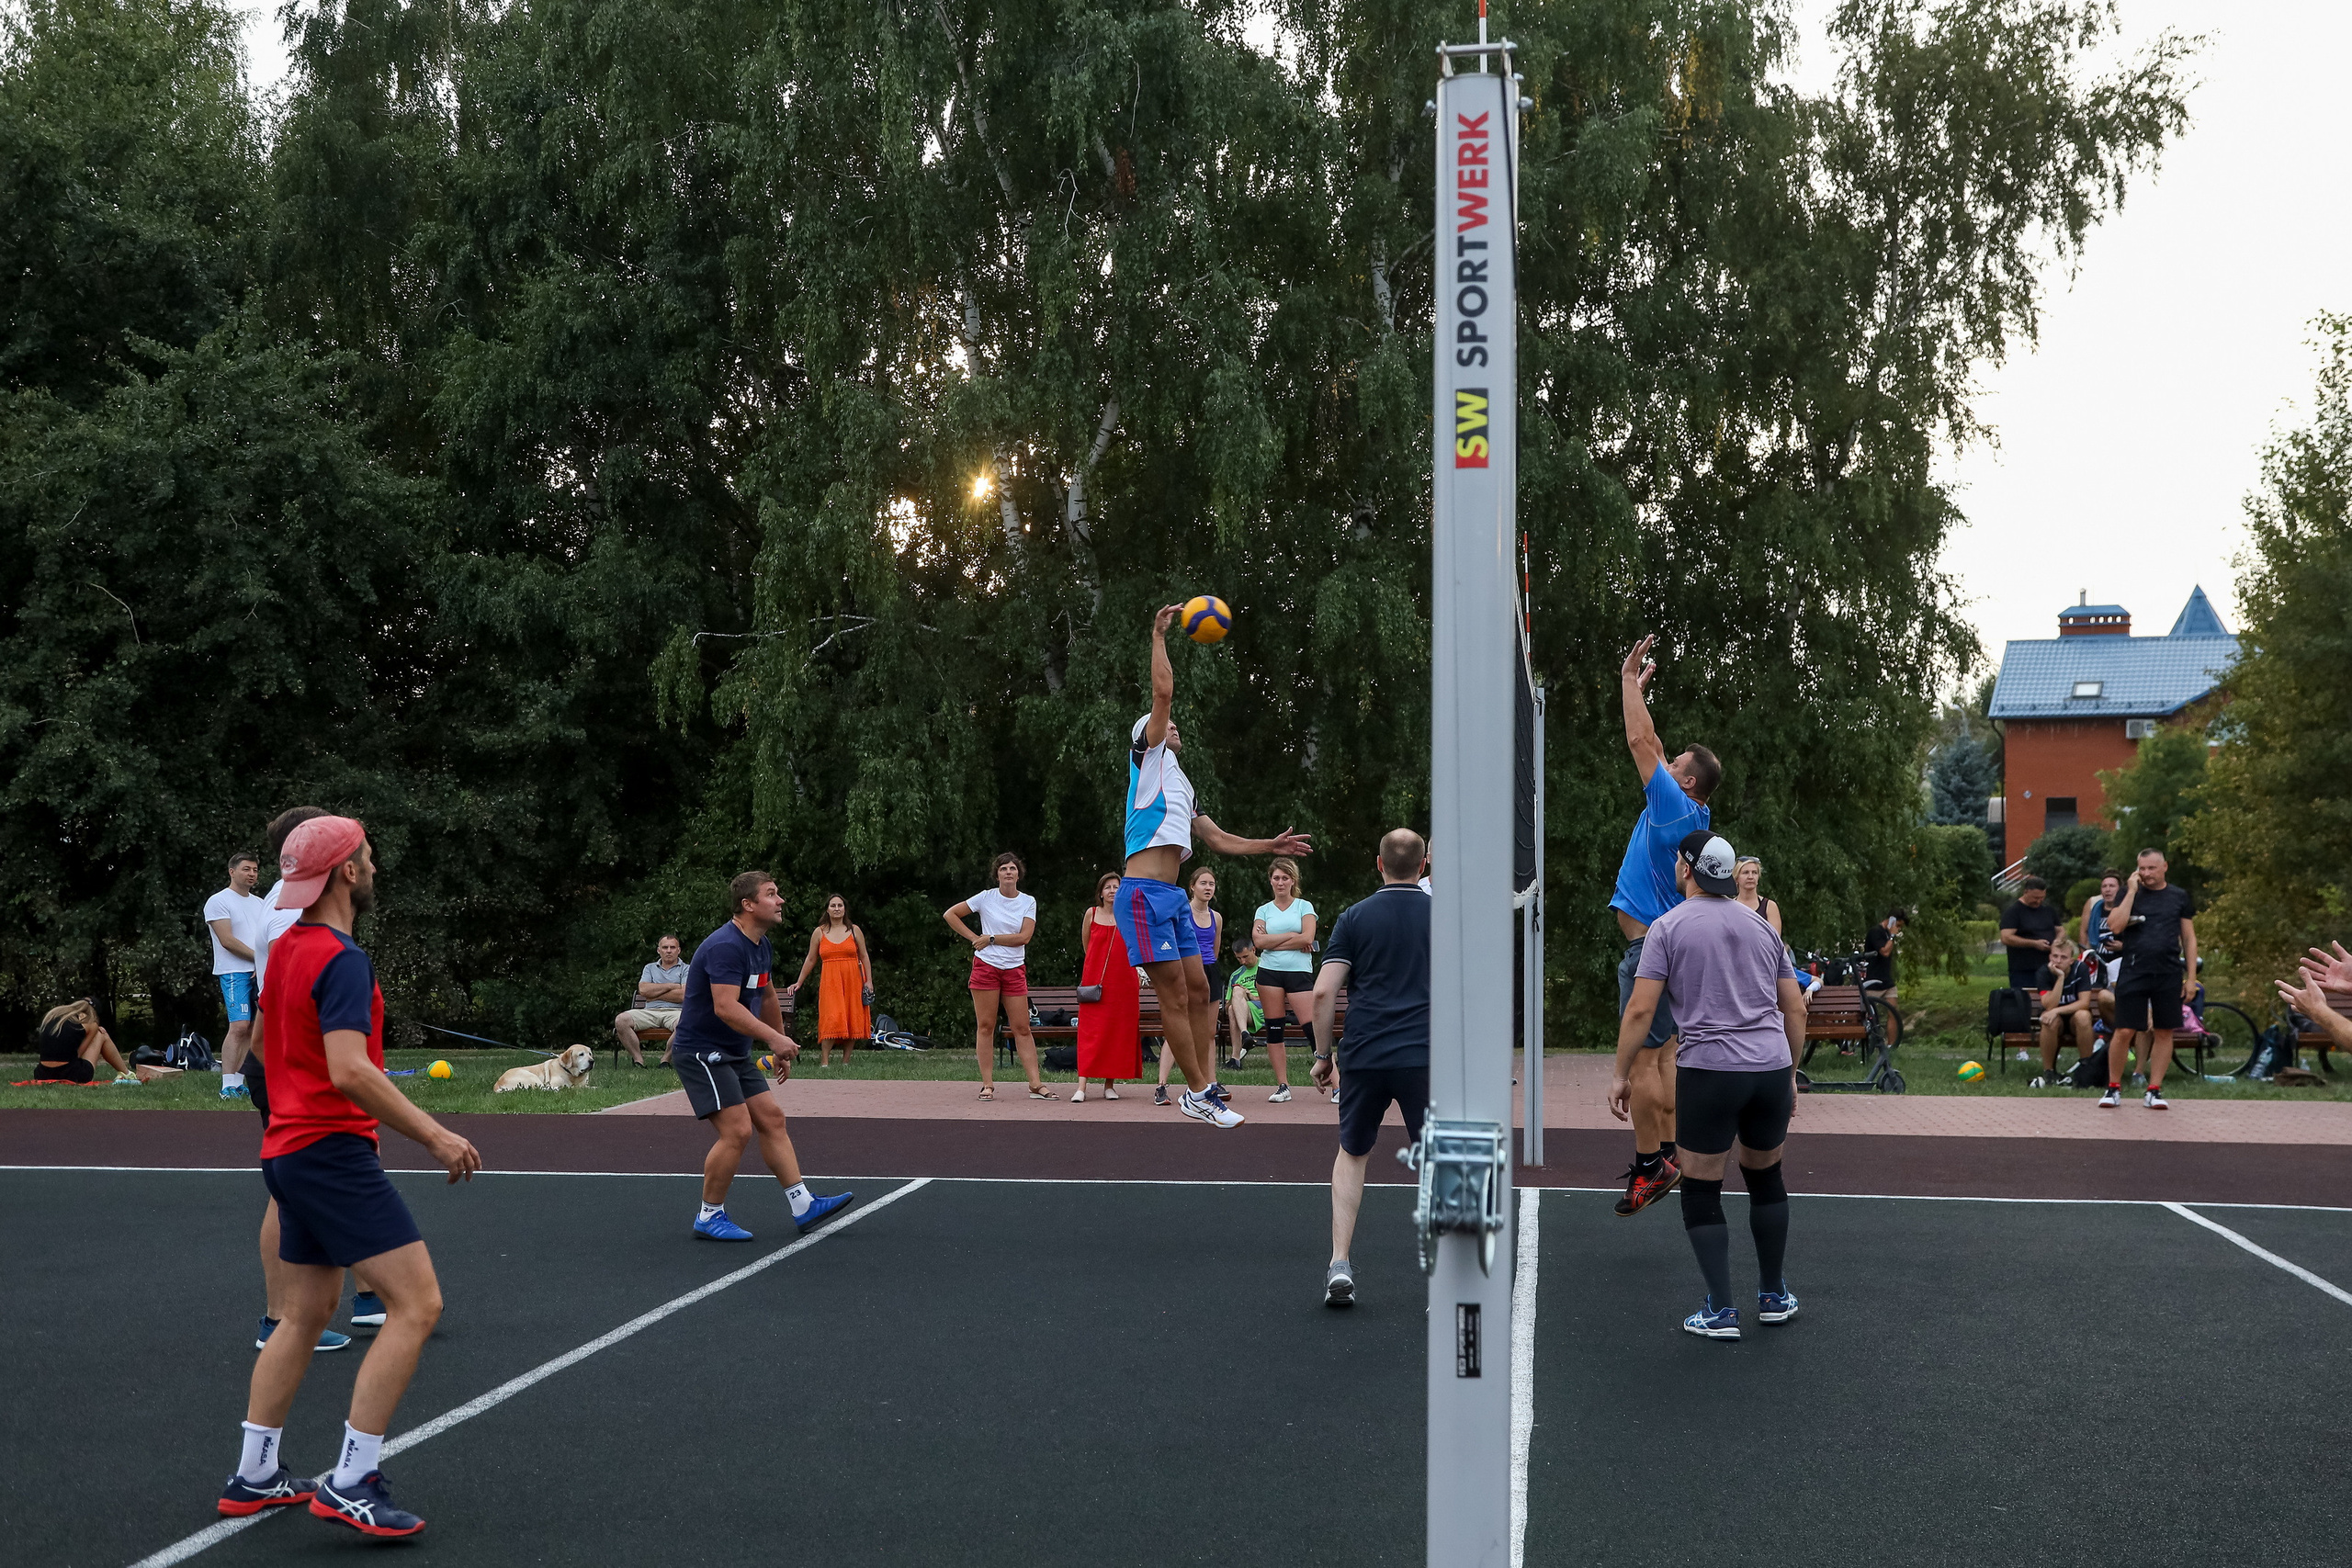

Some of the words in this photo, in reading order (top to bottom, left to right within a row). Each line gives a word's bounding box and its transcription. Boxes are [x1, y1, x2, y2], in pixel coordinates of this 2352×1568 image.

[1456, 110, 1488, 367] SPORTWERK
[1456, 390, 1488, 459] SW
[240, 1003, 249, 1013] 10
[790, 1190, 802, 1199] 23
